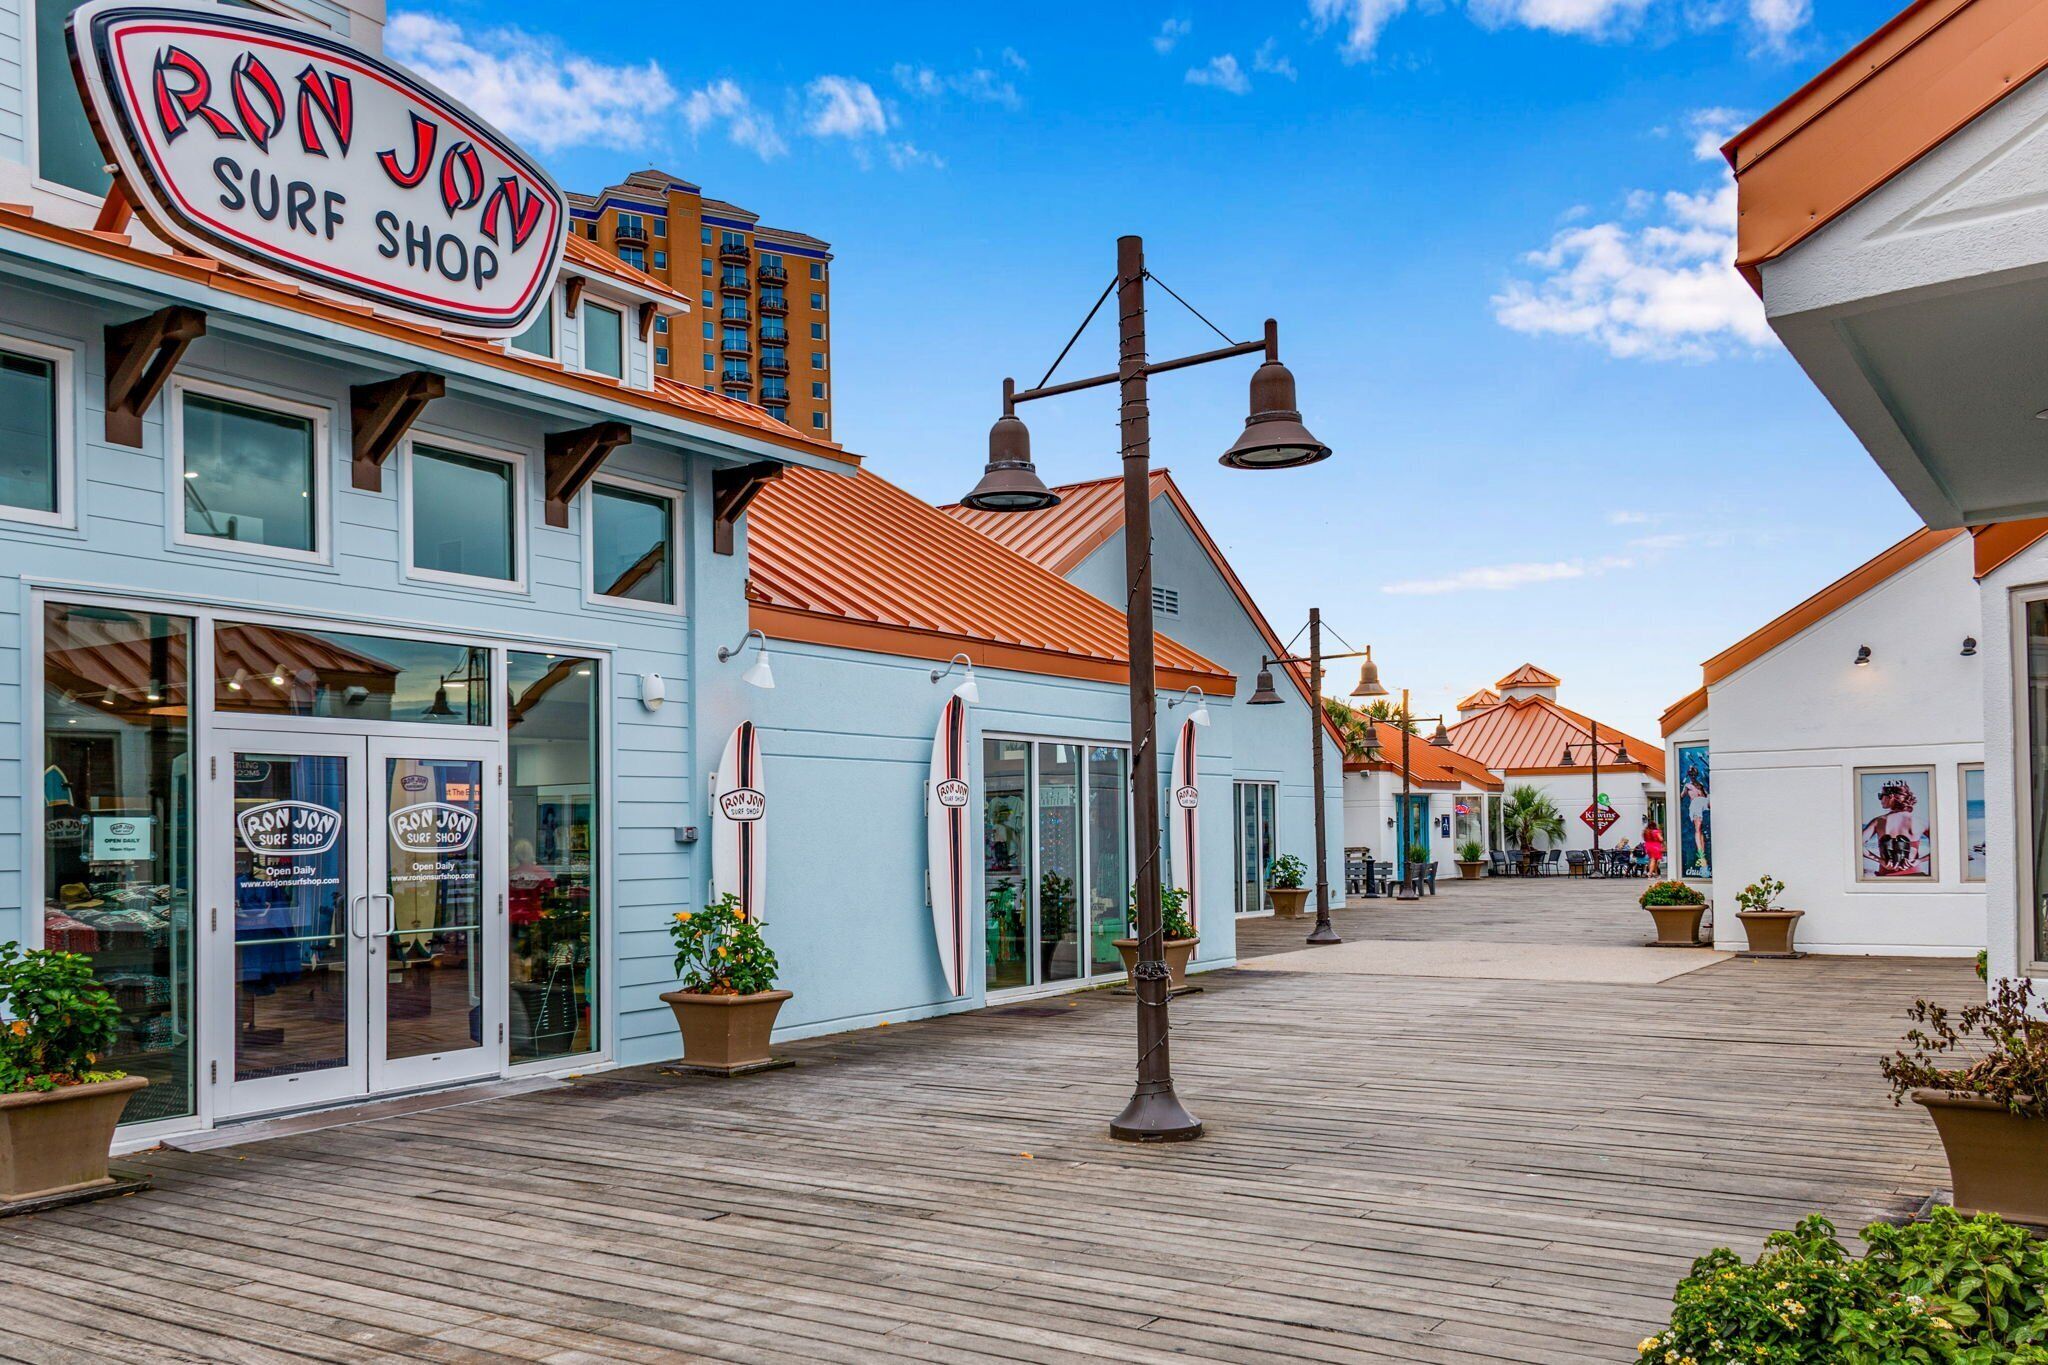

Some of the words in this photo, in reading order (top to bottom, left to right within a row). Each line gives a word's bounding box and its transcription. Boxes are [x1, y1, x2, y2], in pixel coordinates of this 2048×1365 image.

[153, 45, 352, 158] RON
[376, 109, 545, 254] JON
[212, 155, 347, 241] SURF
[375, 209, 499, 291] SHOP
[941, 783, 955, 796] RON
[955, 784, 967, 795] JON
[725, 793, 745, 810] RON
[746, 794, 763, 807] JON
[746, 807, 760, 815] SHOP
[247, 807, 290, 837] RON
[292, 809, 335, 834] JON
[397, 809, 433, 835] RON
[436, 810, 471, 833] JON
[258, 833, 288, 845] SURF
[292, 833, 323, 845] SHOP
[407, 832, 431, 843] SURF
[435, 832, 462, 843] SHOP
[266, 866, 291, 877] Open
[293, 865, 316, 876] Daily
[412, 862, 433, 872] Open
[435, 862, 455, 871] Daily
[240, 877, 340, 888] www.ronjonsurfshop.com
[391, 873, 475, 882] www.ronjonsurfshop.com
